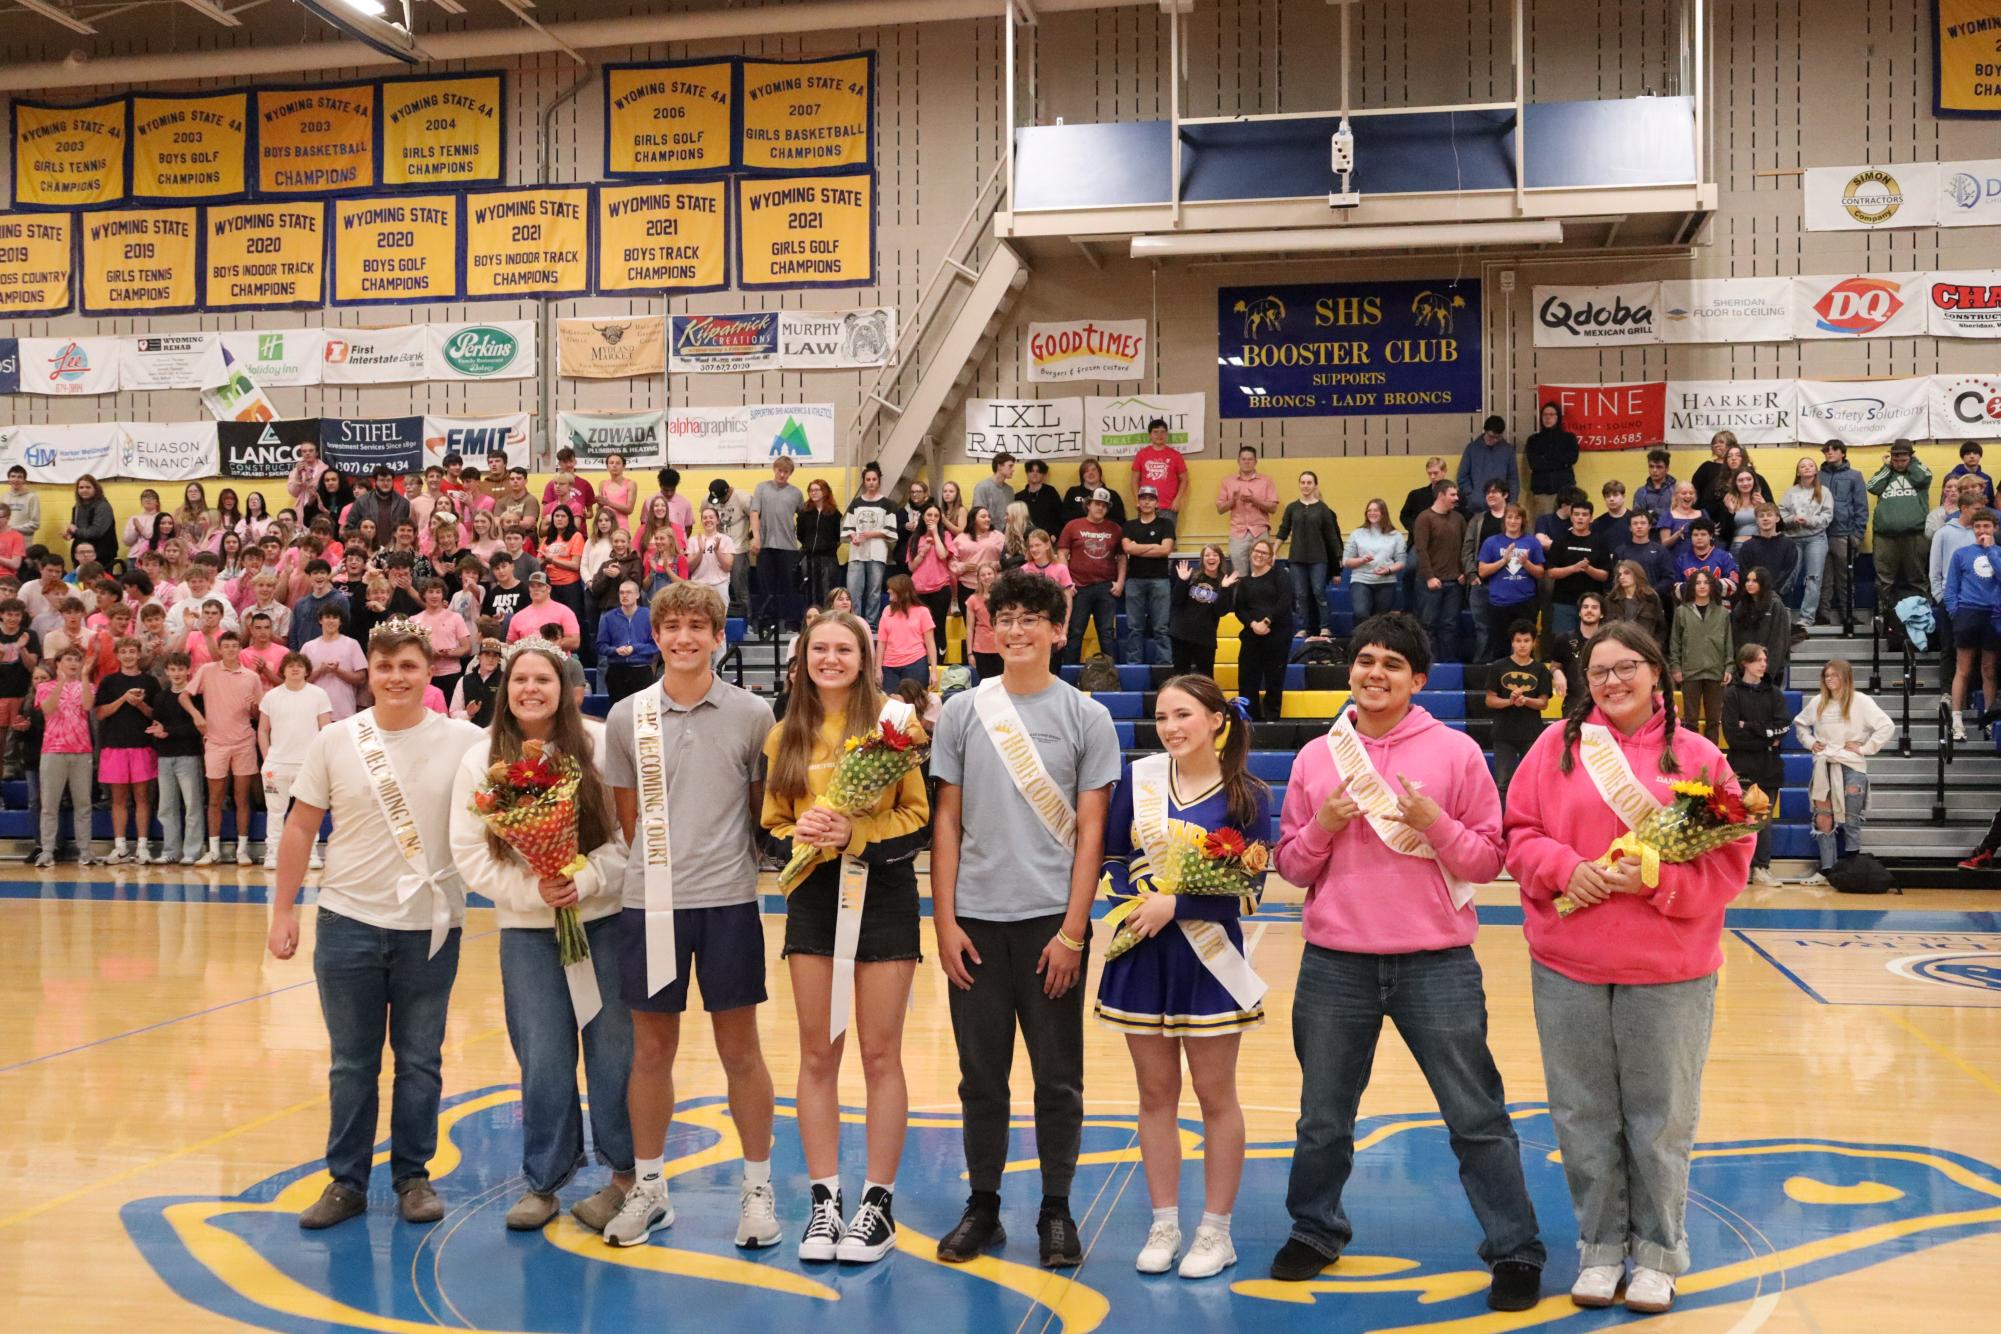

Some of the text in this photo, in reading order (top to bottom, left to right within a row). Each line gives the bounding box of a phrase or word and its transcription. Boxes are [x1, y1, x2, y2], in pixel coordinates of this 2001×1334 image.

[615, 81, 727, 110] WYOMING STATE 4A
[749, 77, 864, 101] WYOMING STATE 4A
[264, 97, 368, 122] WYOMING STATE 4A
[390, 93, 494, 124] WYOMING STATE 4A
[654, 107, 685, 119] 2006
[789, 104, 821, 115] 2007
[138, 111, 242, 136] WYOMING STATE 4A
[300, 121, 331, 132] 2003
[426, 120, 456, 131] 2004
[21, 120, 121, 143] WYOMING STATE 4A
[173, 132, 202, 143] 2003
[635, 132, 704, 146] GIRLS GOLF
[746, 123, 864, 140] GIRLS BASKETBALL
[56, 142, 84, 152] 2003
[264, 141, 367, 157] BOYS BASKETBALL
[403, 144, 479, 158] GIRLS TENNIS
[770, 145, 841, 158] CHAMPIONS
[159, 151, 219, 163] BOYS GOLF
[635, 148, 703, 162] CHAMPIONS
[34, 159, 106, 172] GIRLS TENNIS
[408, 162, 473, 175] CHAMPIONS
[158, 172, 220, 184] CHAMPIONS
[275, 167, 357, 186] CHAMPIONS
[1854, 172, 1891, 186] SIMON
[40, 180, 100, 192] CHAMPIONS
[609, 195, 716, 218] WYOMING STATE
[750, 188, 862, 211] WYOMING STATE
[1841, 196, 1903, 205] CONTRACTORS
[344, 208, 447, 230] WYOMING STATE
[476, 200, 579, 224] WYOMING STATE
[1854, 209, 1892, 222] Company
[215, 214, 315, 236] WYOMING STATE
[647, 219, 677, 236] 2021
[789, 212, 822, 229] 2021
[27, 224, 62, 241] STATE
[91, 220, 188, 241] WYOMING STATE
[512, 224, 541, 241] 2021
[247, 237, 281, 253] 2020
[378, 232, 413, 248] 2020
[772, 240, 839, 255] GIRLS GOLF
[124, 244, 154, 259] 2019
[474, 251, 578, 266] BOYS INDOOR TRACK
[624, 246, 699, 262] BOYS TRACK
[214, 262, 314, 278] BOYS INDOOR TRACK
[364, 257, 426, 272] BOYS GOLF
[771, 260, 841, 274] CHAMPIONS
[22, 271, 67, 283] COUNTRY
[107, 268, 172, 282] GIRLS TENNIS
[494, 271, 558, 285] CHAMPIONS
[628, 266, 696, 281] CHAMPIONS
[231, 282, 295, 296] CHAMPIONS
[362, 276, 428, 291] CHAMPIONS
[109, 287, 169, 301] CHAMPIONS
[1713, 298, 1765, 307] SHERIDAN
[1827, 290, 1892, 322] DQ
[1315, 297, 1383, 327] SHS
[1539, 295, 1652, 336] Qdoba
[1693, 307, 1785, 318] FLOOR to CEILING
[678, 313, 770, 348] Kilpatrick
[782, 323, 841, 336] MURPHY
[1583, 327, 1653, 337] MEXICAN GRILL
[449, 332, 512, 359] Perkins
[712, 336, 771, 345] CREATIONS
[351, 345, 374, 354] First
[784, 343, 839, 355] LAW
[1241, 338, 1458, 367] BOOSTER CLUB
[349, 355, 399, 365] Interstate
[399, 352, 424, 361] Bank
[1041, 367, 1067, 378] Burgers
[1077, 365, 1100, 374] frozen
[1313, 372, 1386, 385] SUPPORTS
[1249, 391, 1451, 408] BRONCS LADY BRONCS
[1561, 389, 1644, 416] FINE
[1683, 391, 1780, 410] HARKER
[989, 404, 1060, 428] IXL
[1671, 410, 1789, 429] MELLINGER
[1801, 406, 1925, 422] Life Safety Solutions
[341, 420, 402, 442] STIFEL
[669, 416, 748, 437] alphagraphics
[1606, 420, 1642, 430] SOUND
[1838, 423, 1886, 433] of Sheridan
[446, 427, 512, 456] EMIT
[588, 426, 657, 443] ZOWADA
[137, 441, 200, 453] ELIASON
[327, 441, 359, 450] Investment
[385, 442, 402, 450] Since
[629, 445, 658, 453] HEATING
[967, 432, 1081, 454] RANCH
[138, 454, 211, 468] FINANCIAL
[1080, 531, 1112, 541] Wrangler
[492, 593, 520, 607] JUST
